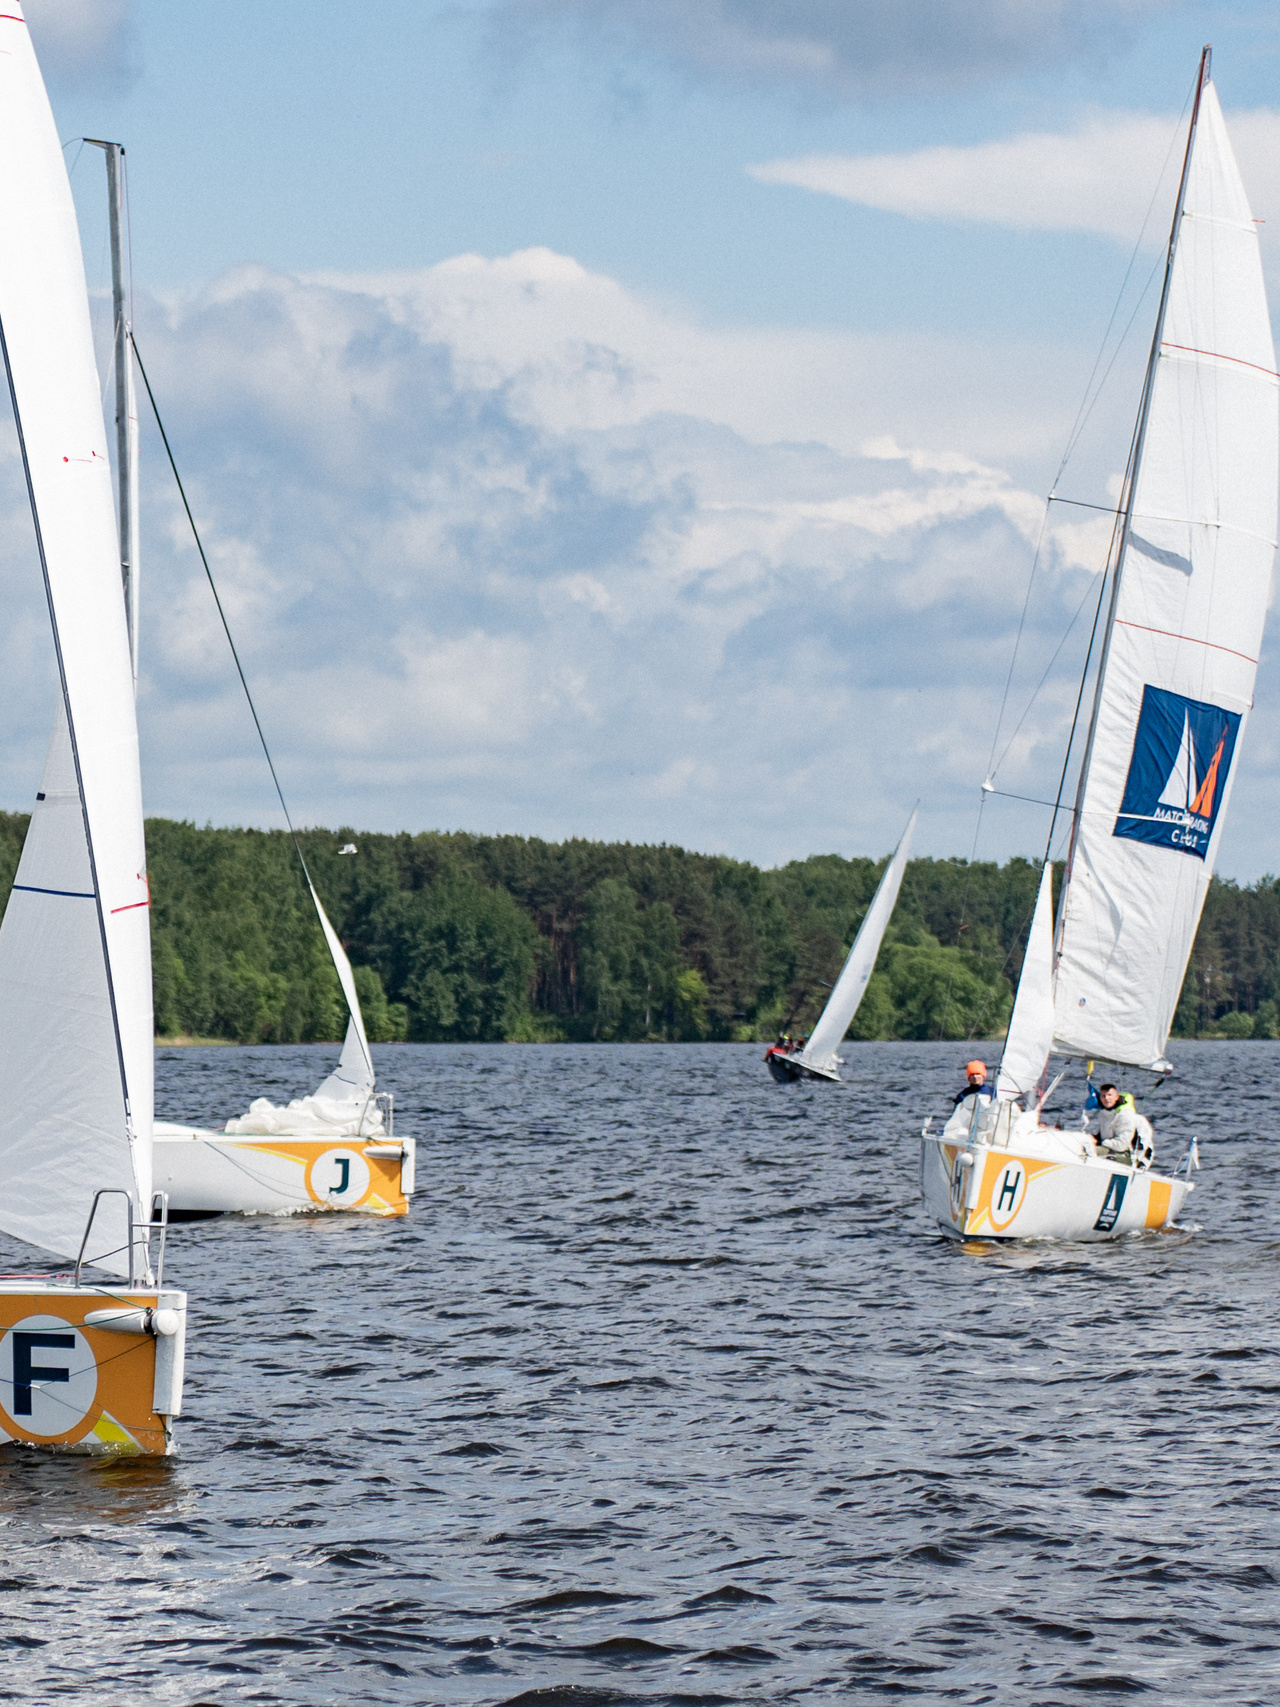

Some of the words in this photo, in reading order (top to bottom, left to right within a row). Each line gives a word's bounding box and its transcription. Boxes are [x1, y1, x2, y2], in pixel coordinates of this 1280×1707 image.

[1153, 807, 1190, 825] MATC
[329, 1158, 350, 1194] J
[997, 1170, 1021, 1212] H
[13, 1332, 75, 1416] F
